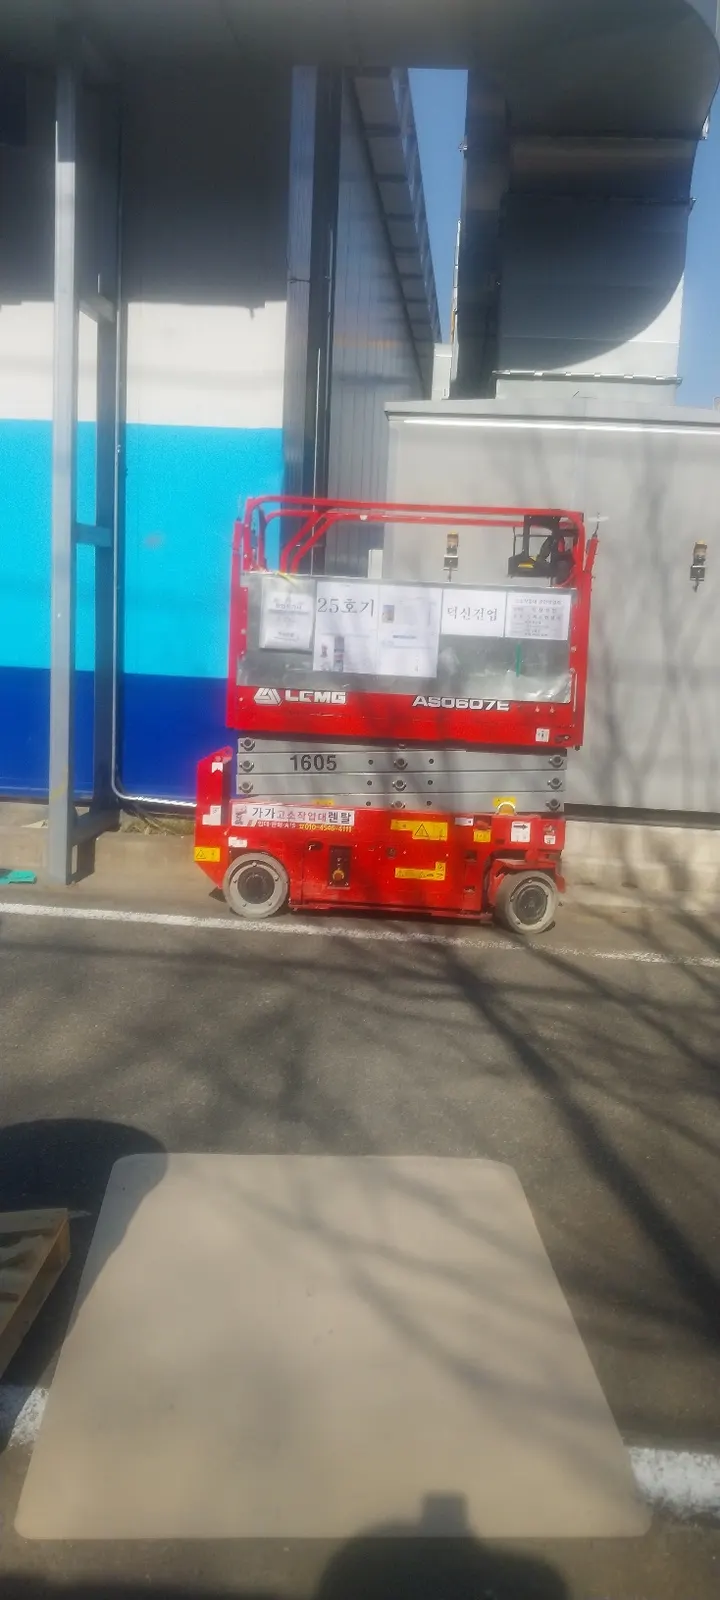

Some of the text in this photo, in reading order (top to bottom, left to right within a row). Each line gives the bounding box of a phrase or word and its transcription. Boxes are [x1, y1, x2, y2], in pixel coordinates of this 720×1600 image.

[317, 598, 375, 617] 25호기
[285, 689, 347, 705] LCMG
[289, 754, 337, 771] 1605
